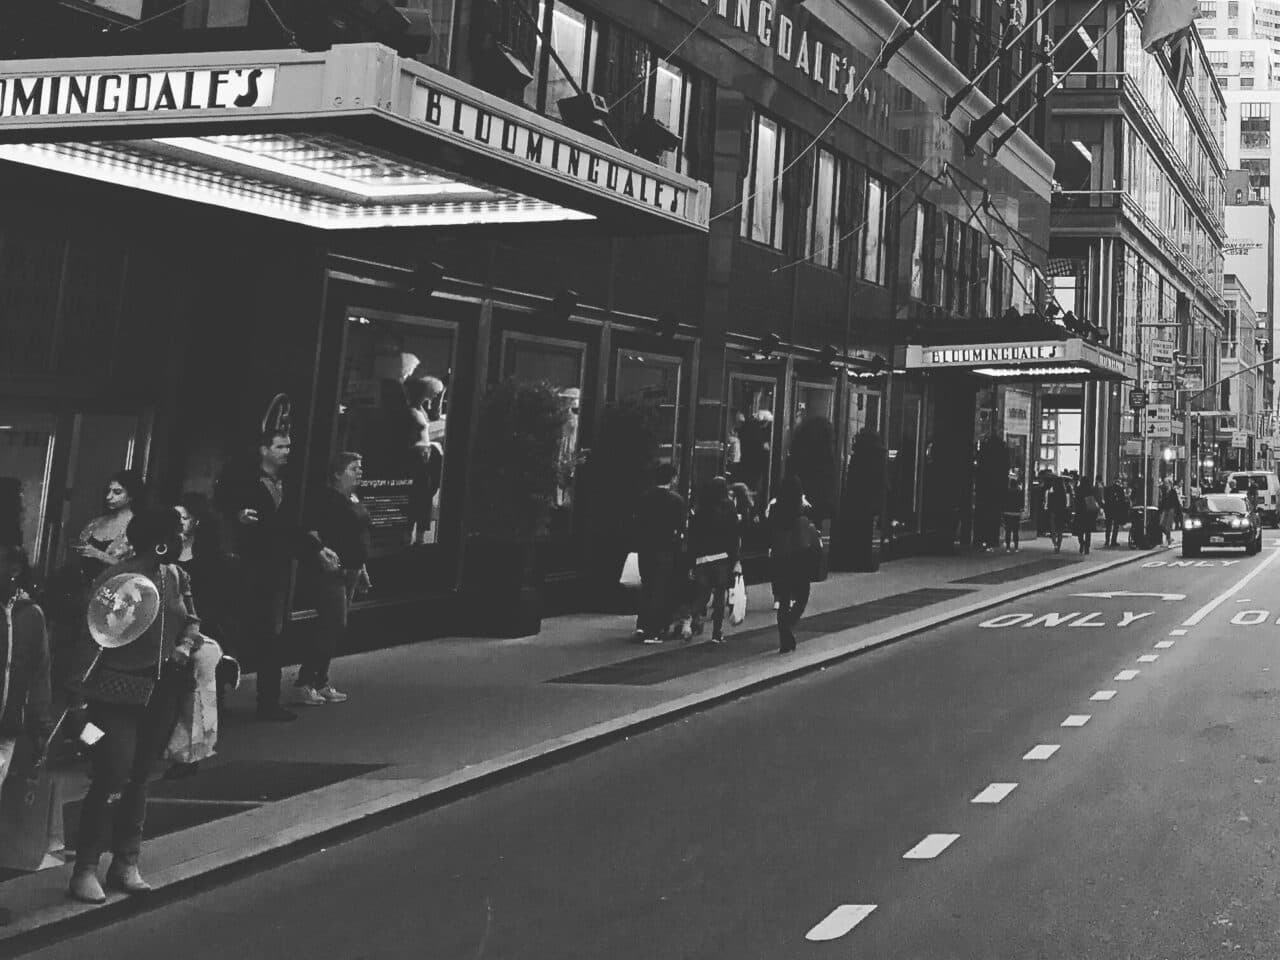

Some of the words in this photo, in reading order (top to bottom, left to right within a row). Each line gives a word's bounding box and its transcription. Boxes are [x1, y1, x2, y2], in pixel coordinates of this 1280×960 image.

[0, 68, 263, 117] MINGDALE'S
[1141, 560, 1241, 568] ONLY
[978, 610, 1156, 629] ONLY
